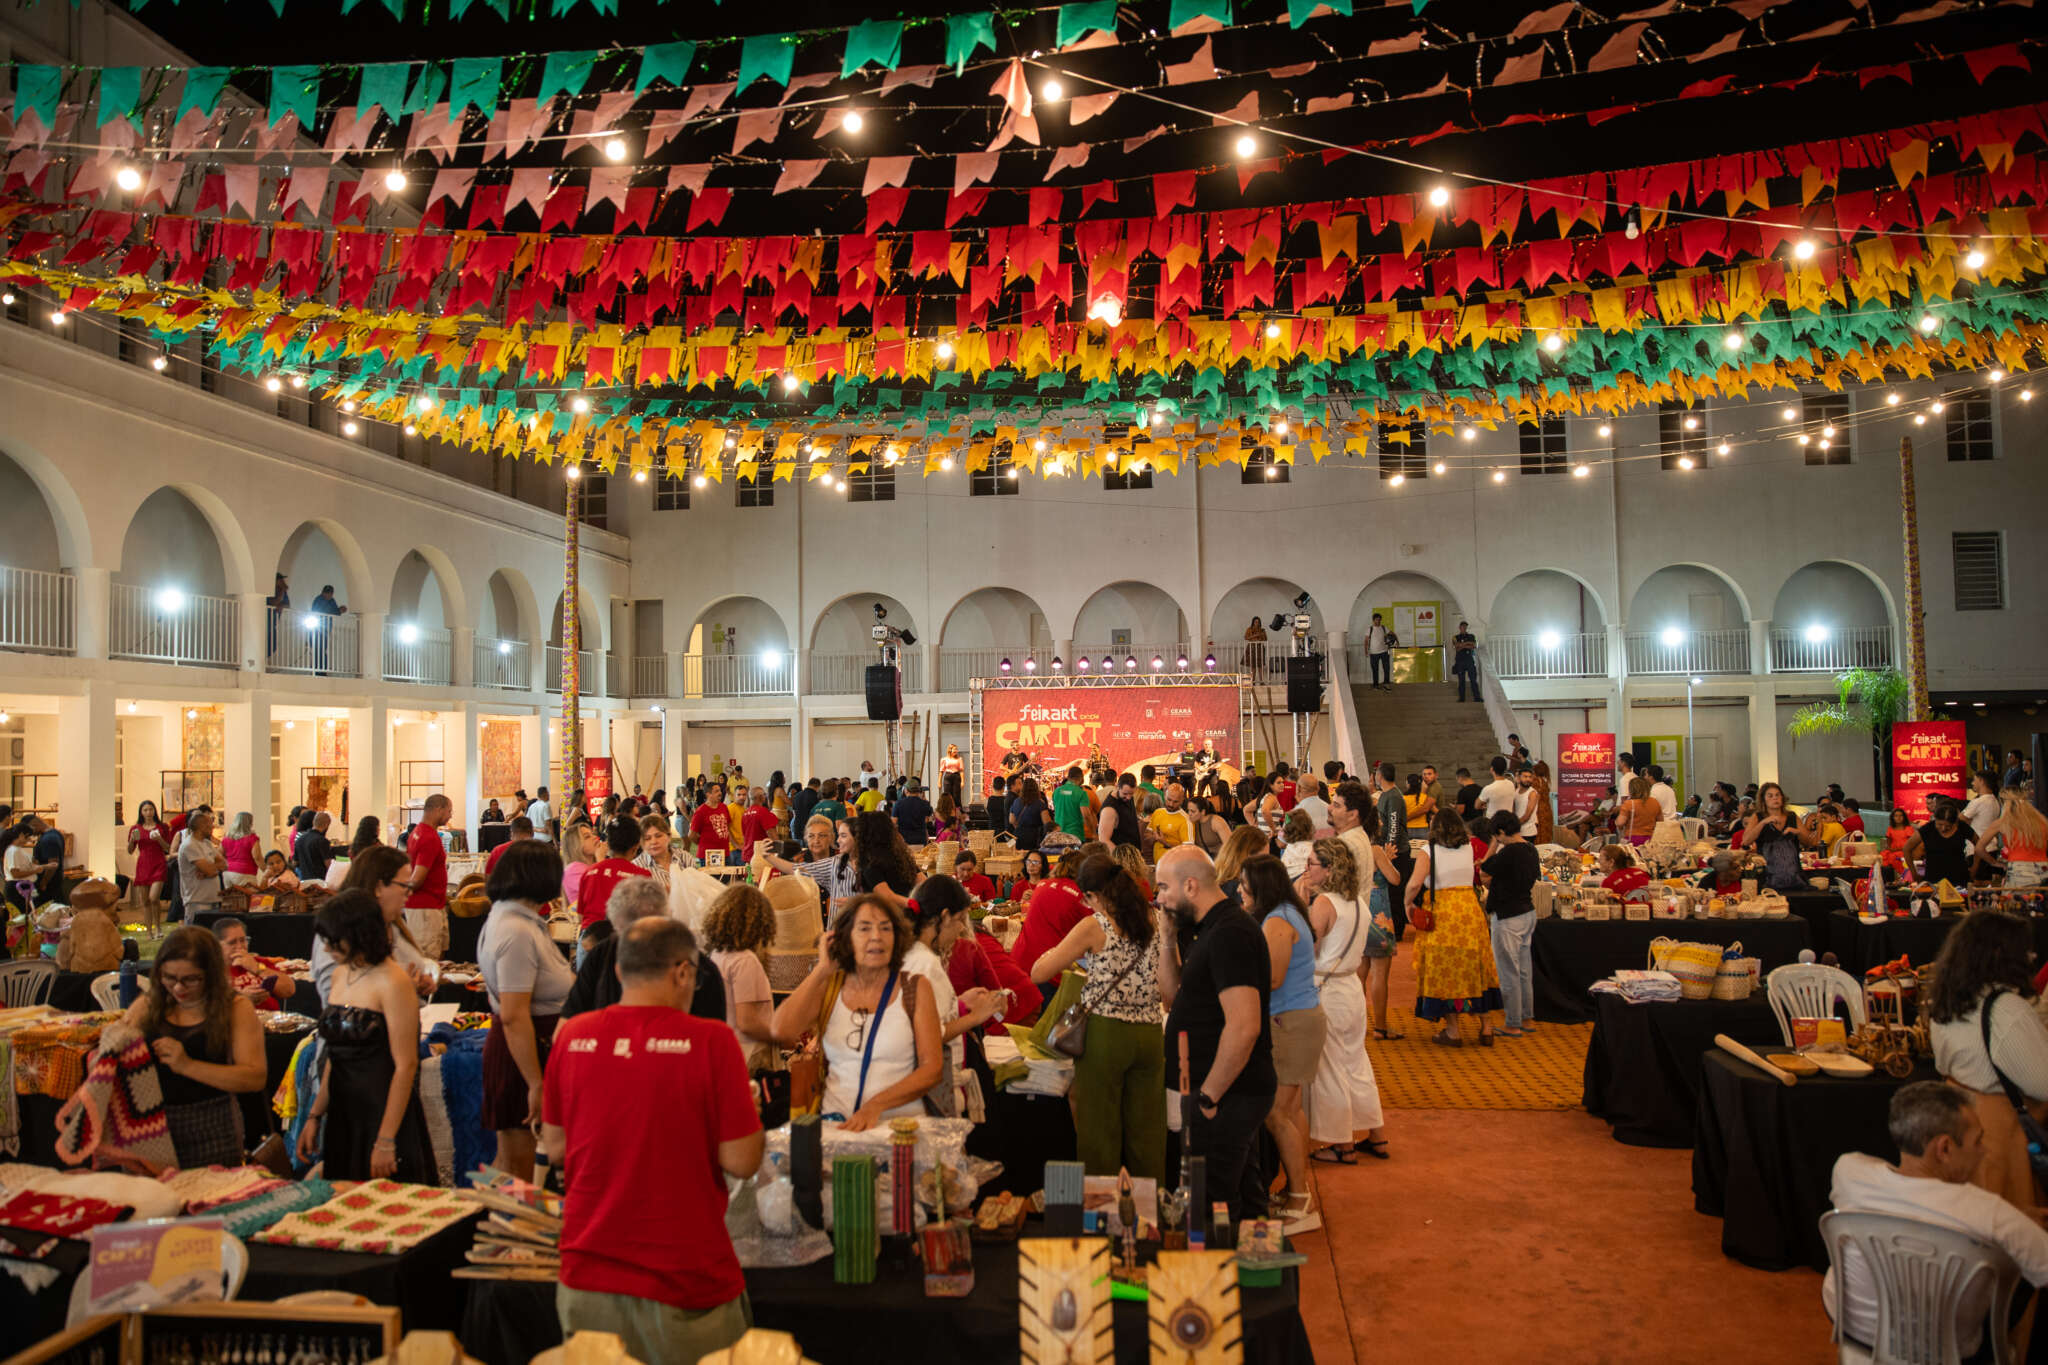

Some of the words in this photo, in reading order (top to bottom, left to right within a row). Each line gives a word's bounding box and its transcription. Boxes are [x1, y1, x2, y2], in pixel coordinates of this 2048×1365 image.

[996, 722, 1102, 749] CARIRI
[1560, 751, 1613, 765] CARIRI
[1896, 743, 1962, 761] CARIRI
[1900, 772, 1960, 784] OFICINAS
